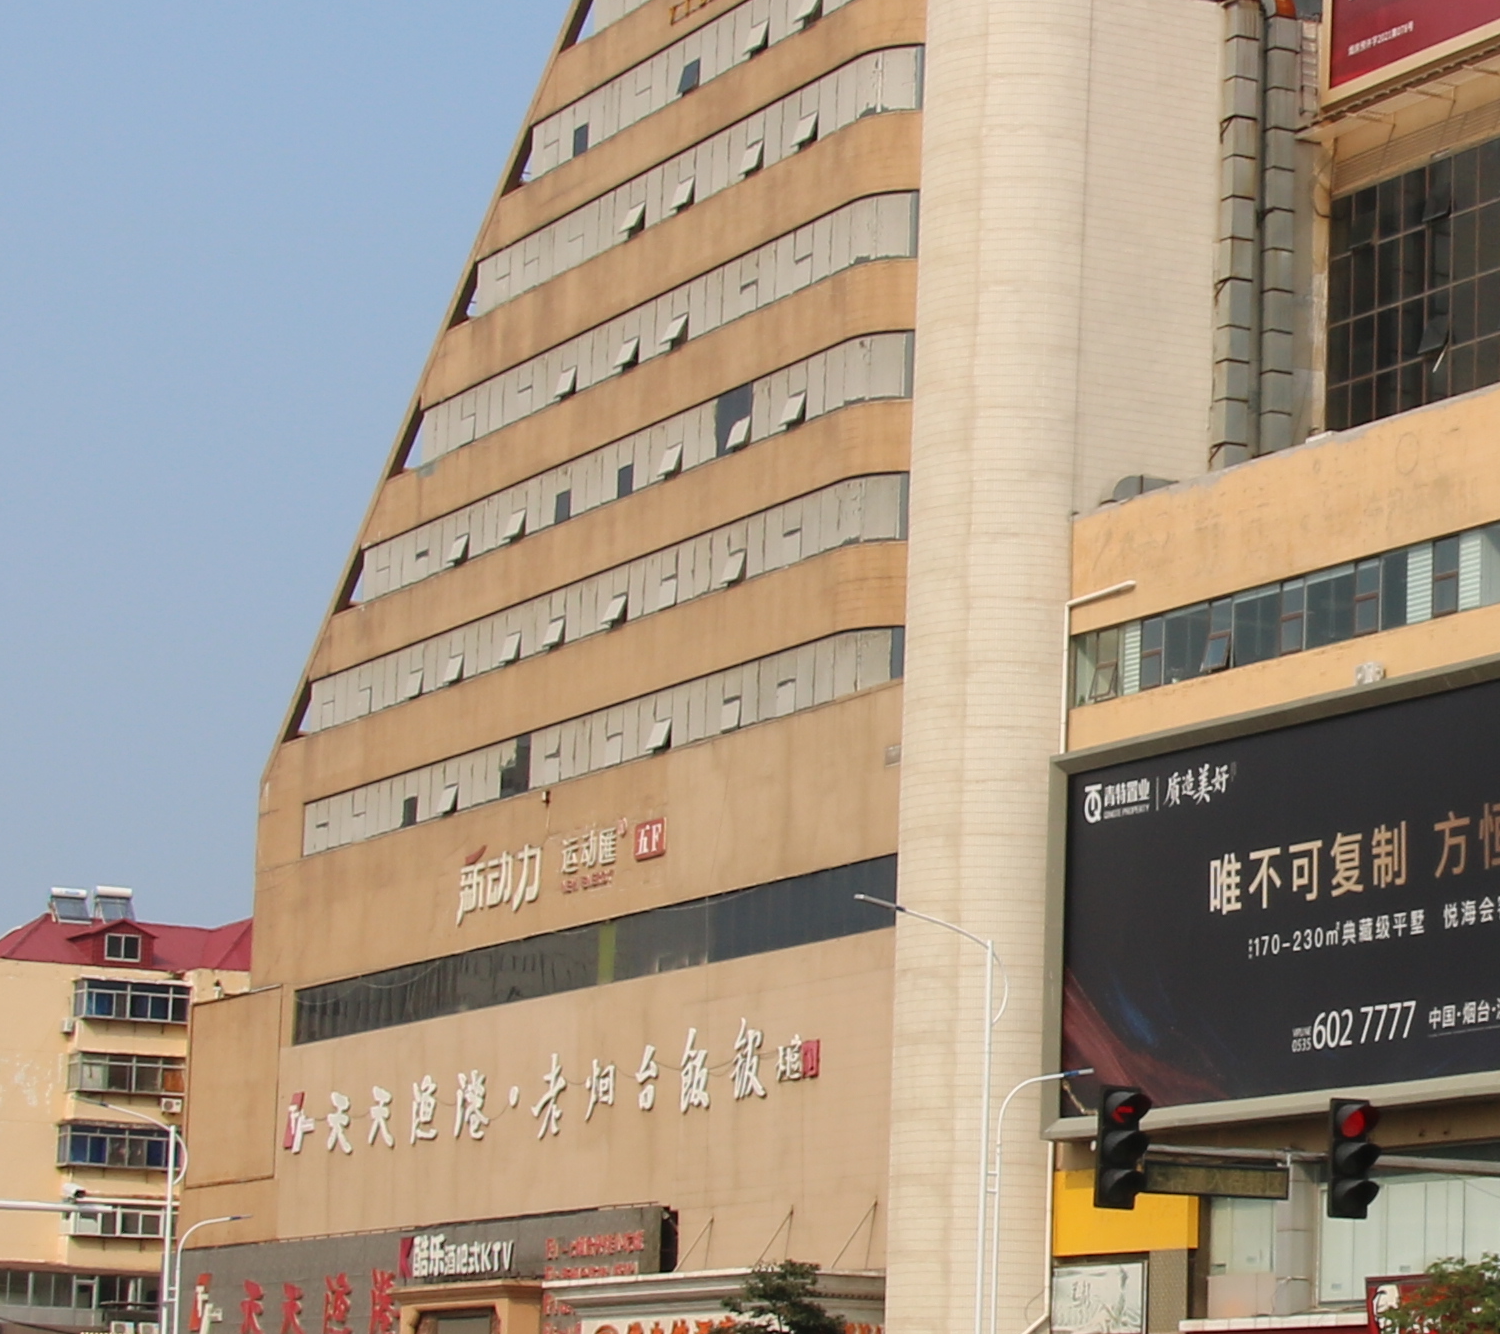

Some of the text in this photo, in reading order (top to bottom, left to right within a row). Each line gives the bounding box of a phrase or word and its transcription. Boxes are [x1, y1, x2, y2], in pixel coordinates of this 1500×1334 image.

[1104, 777, 1151, 808] 青特置业
[455, 844, 543, 928] 新动力
[1208, 820, 1409, 916] 唯不可复制
[1312, 1010, 1353, 1051] 602
[1359, 999, 1418, 1045] 7777
